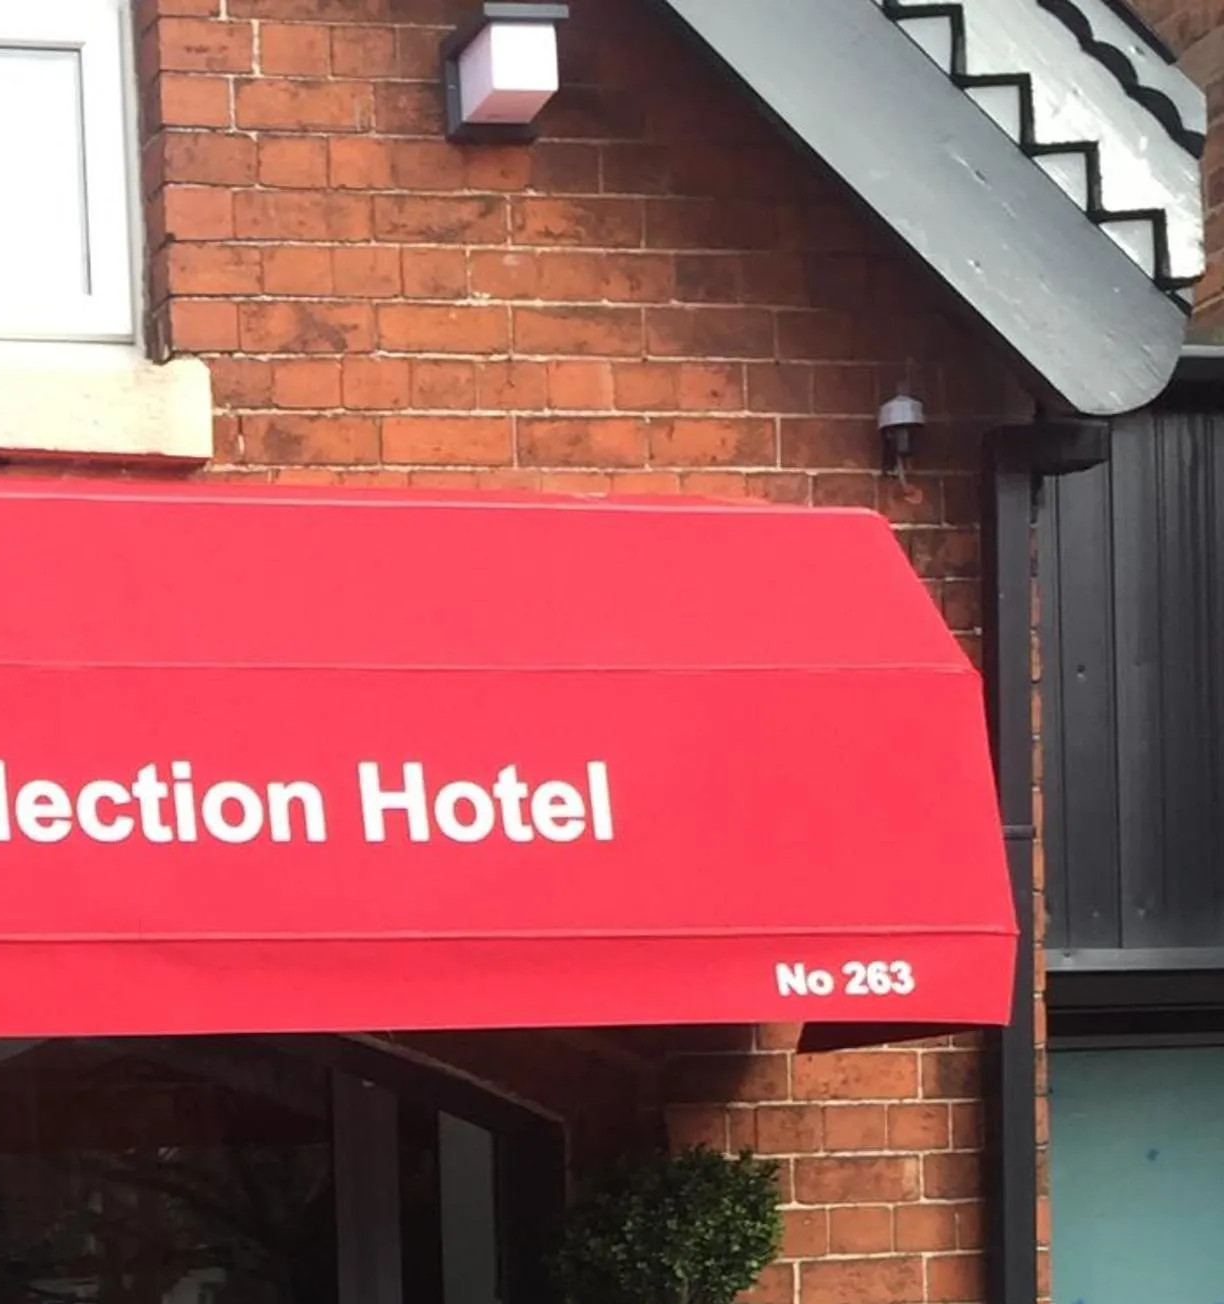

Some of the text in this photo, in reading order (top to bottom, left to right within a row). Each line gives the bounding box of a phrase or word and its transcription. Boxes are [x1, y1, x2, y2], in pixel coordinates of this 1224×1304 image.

[358, 761, 615, 843] Hotel
[775, 960, 916, 996] No 263
